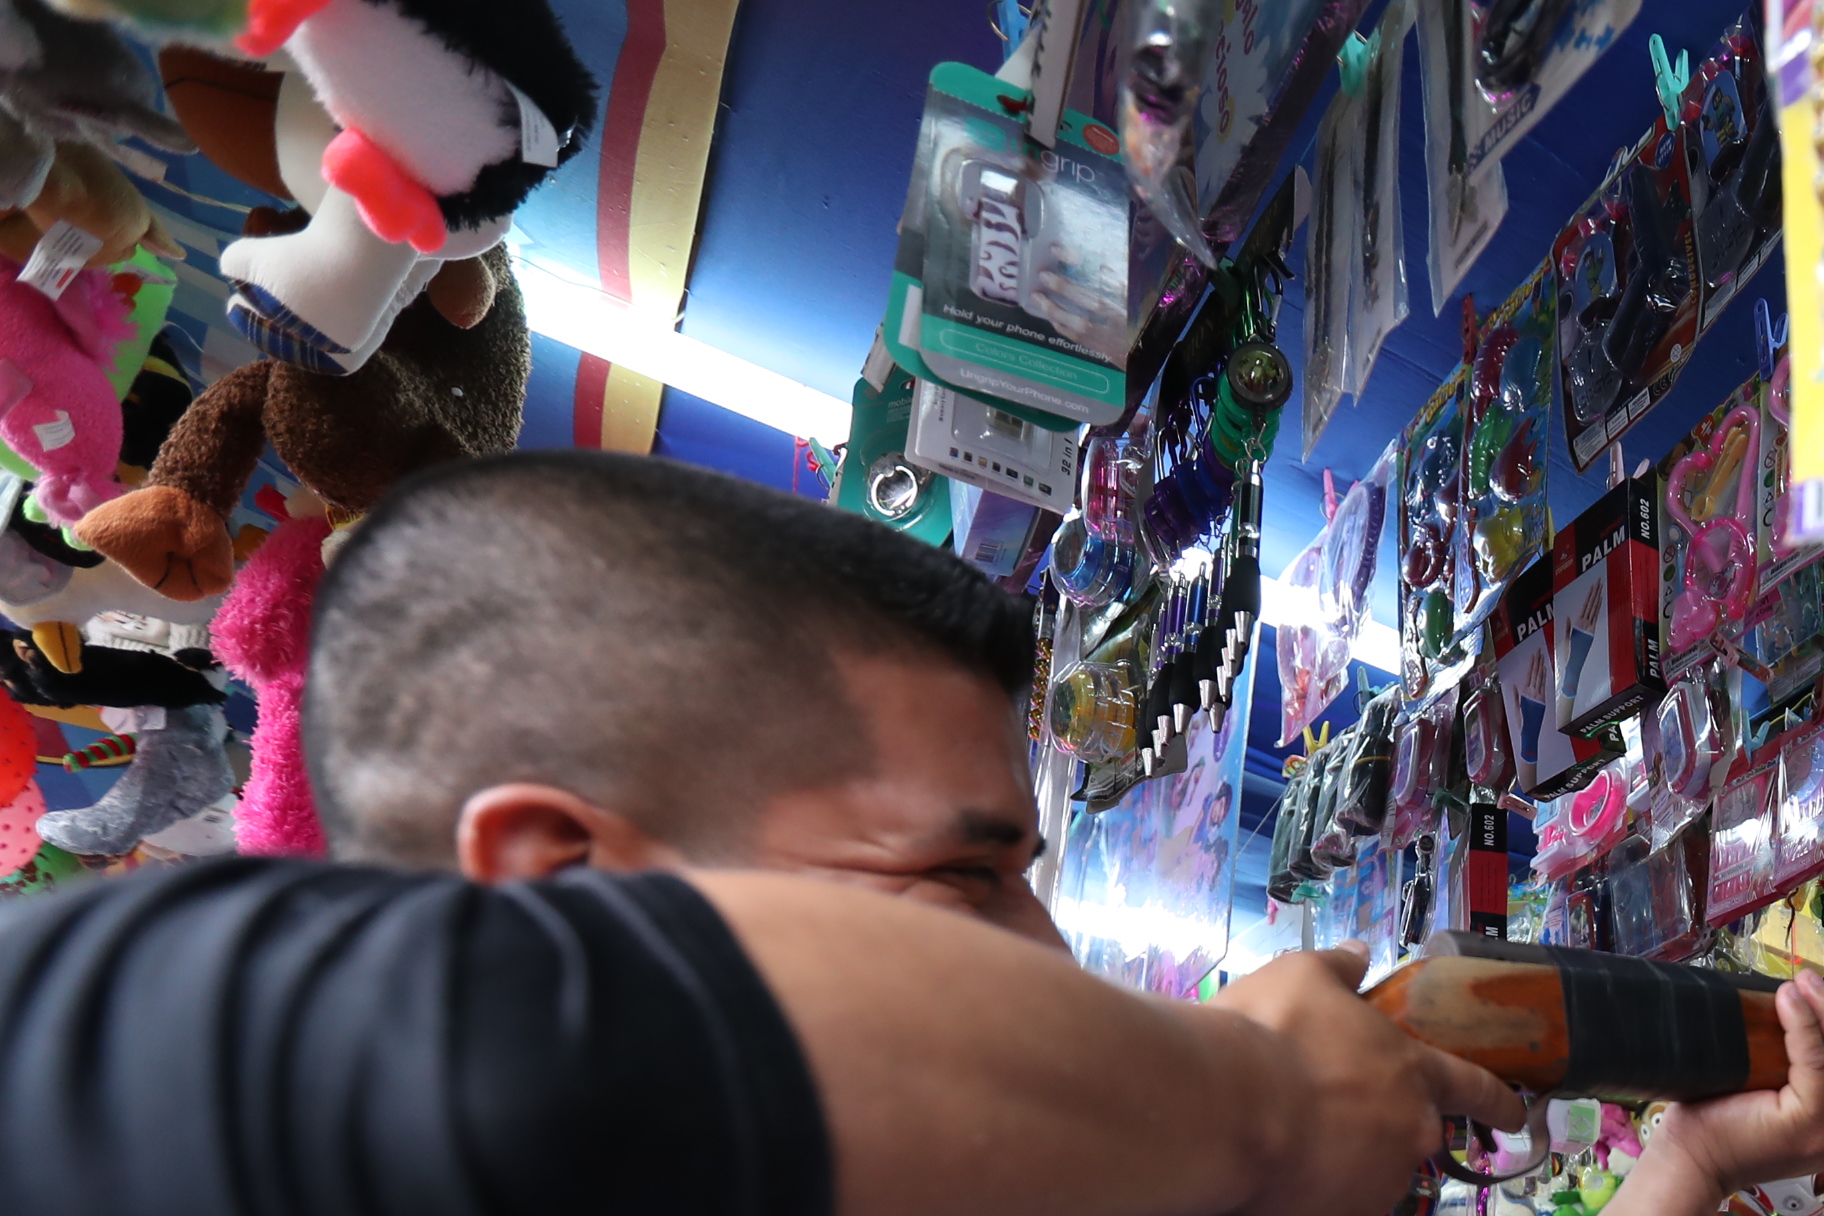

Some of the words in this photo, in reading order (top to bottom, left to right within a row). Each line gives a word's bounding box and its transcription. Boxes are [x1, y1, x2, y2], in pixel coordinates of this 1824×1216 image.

[943, 303, 974, 320] Hold
[975, 313, 1004, 328] your
[1006, 322, 1045, 342] phone
[1048, 335, 1112, 364] effortlessly
[975, 341, 1016, 362] Colors
[1018, 350, 1078, 380] Collection
[959, 367, 1090, 415] UngripYourPhone.com
[1060, 459, 1072, 476] 32
[1062, 444, 1073, 459] in
[1639, 498, 1650, 540] NO.602
[1581, 525, 1626, 573] PALM
[1649, 638, 1661, 680] PALM
[1579, 716, 1604, 735] PALM
[1603, 694, 1645, 720] SUPPORT
[1565, 757, 1606, 789] SUPPORT
[1483, 814, 1495, 847] NO.602
